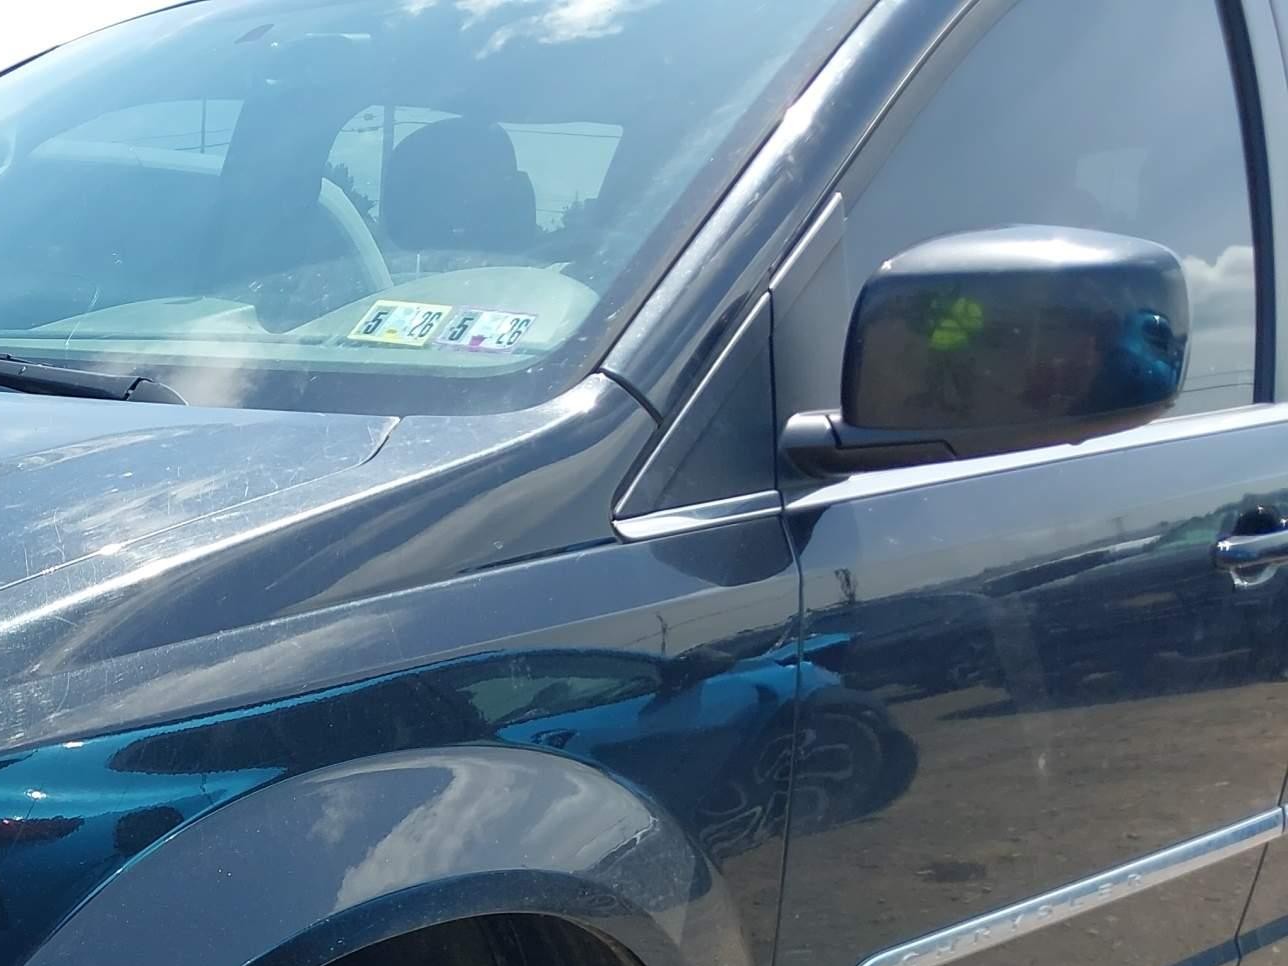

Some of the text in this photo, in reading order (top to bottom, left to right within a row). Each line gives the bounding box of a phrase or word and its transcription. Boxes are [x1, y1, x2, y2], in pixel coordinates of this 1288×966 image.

[364, 311, 442, 338] 5 26
[449, 317, 530, 345] 5 26
